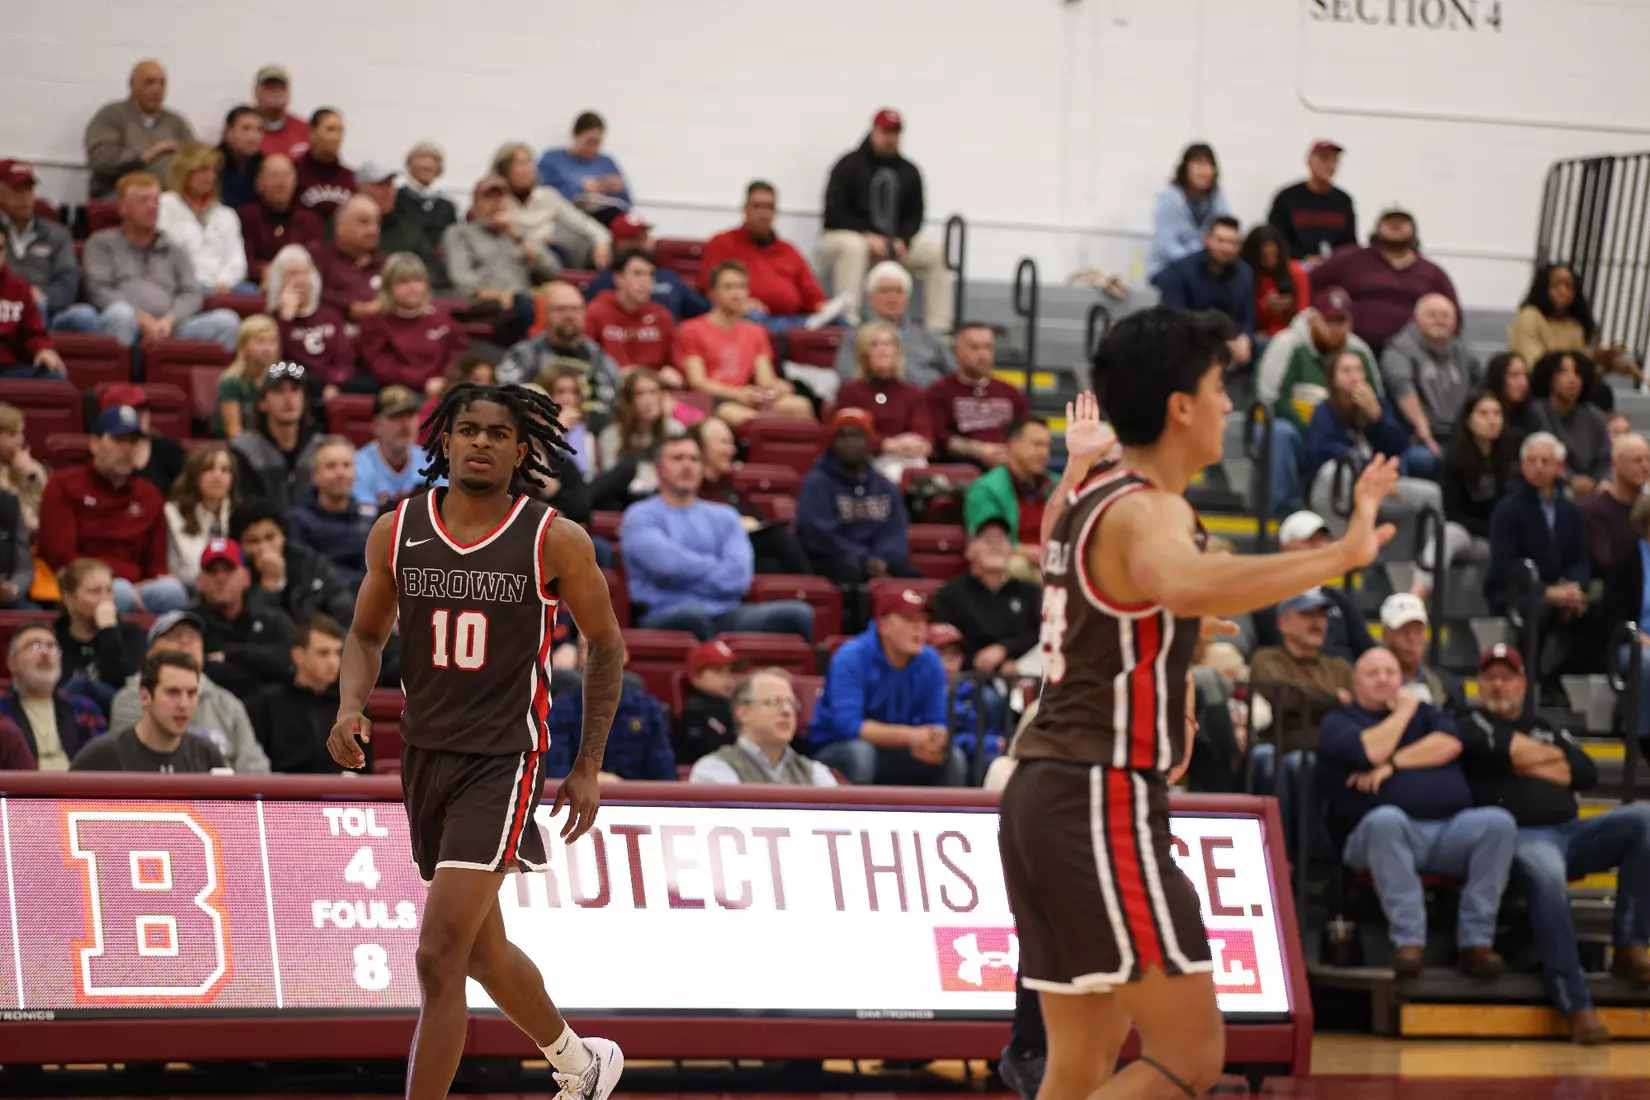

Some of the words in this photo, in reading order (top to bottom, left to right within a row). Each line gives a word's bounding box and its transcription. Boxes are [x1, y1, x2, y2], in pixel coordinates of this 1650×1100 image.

[1309, 0, 1478, 31] SECTION
[1485, 0, 1503, 33] 4
[402, 567, 528, 603] BROWN
[430, 607, 489, 671] 10
[322, 806, 389, 837] TOL
[344, 845, 381, 889] 4
[514, 823, 791, 910] ROTECT
[811, 828, 979, 912] THIS
[60, 804, 234, 1003] B
[311, 899, 417, 929] FOULS
[352, 943, 391, 991] 8
